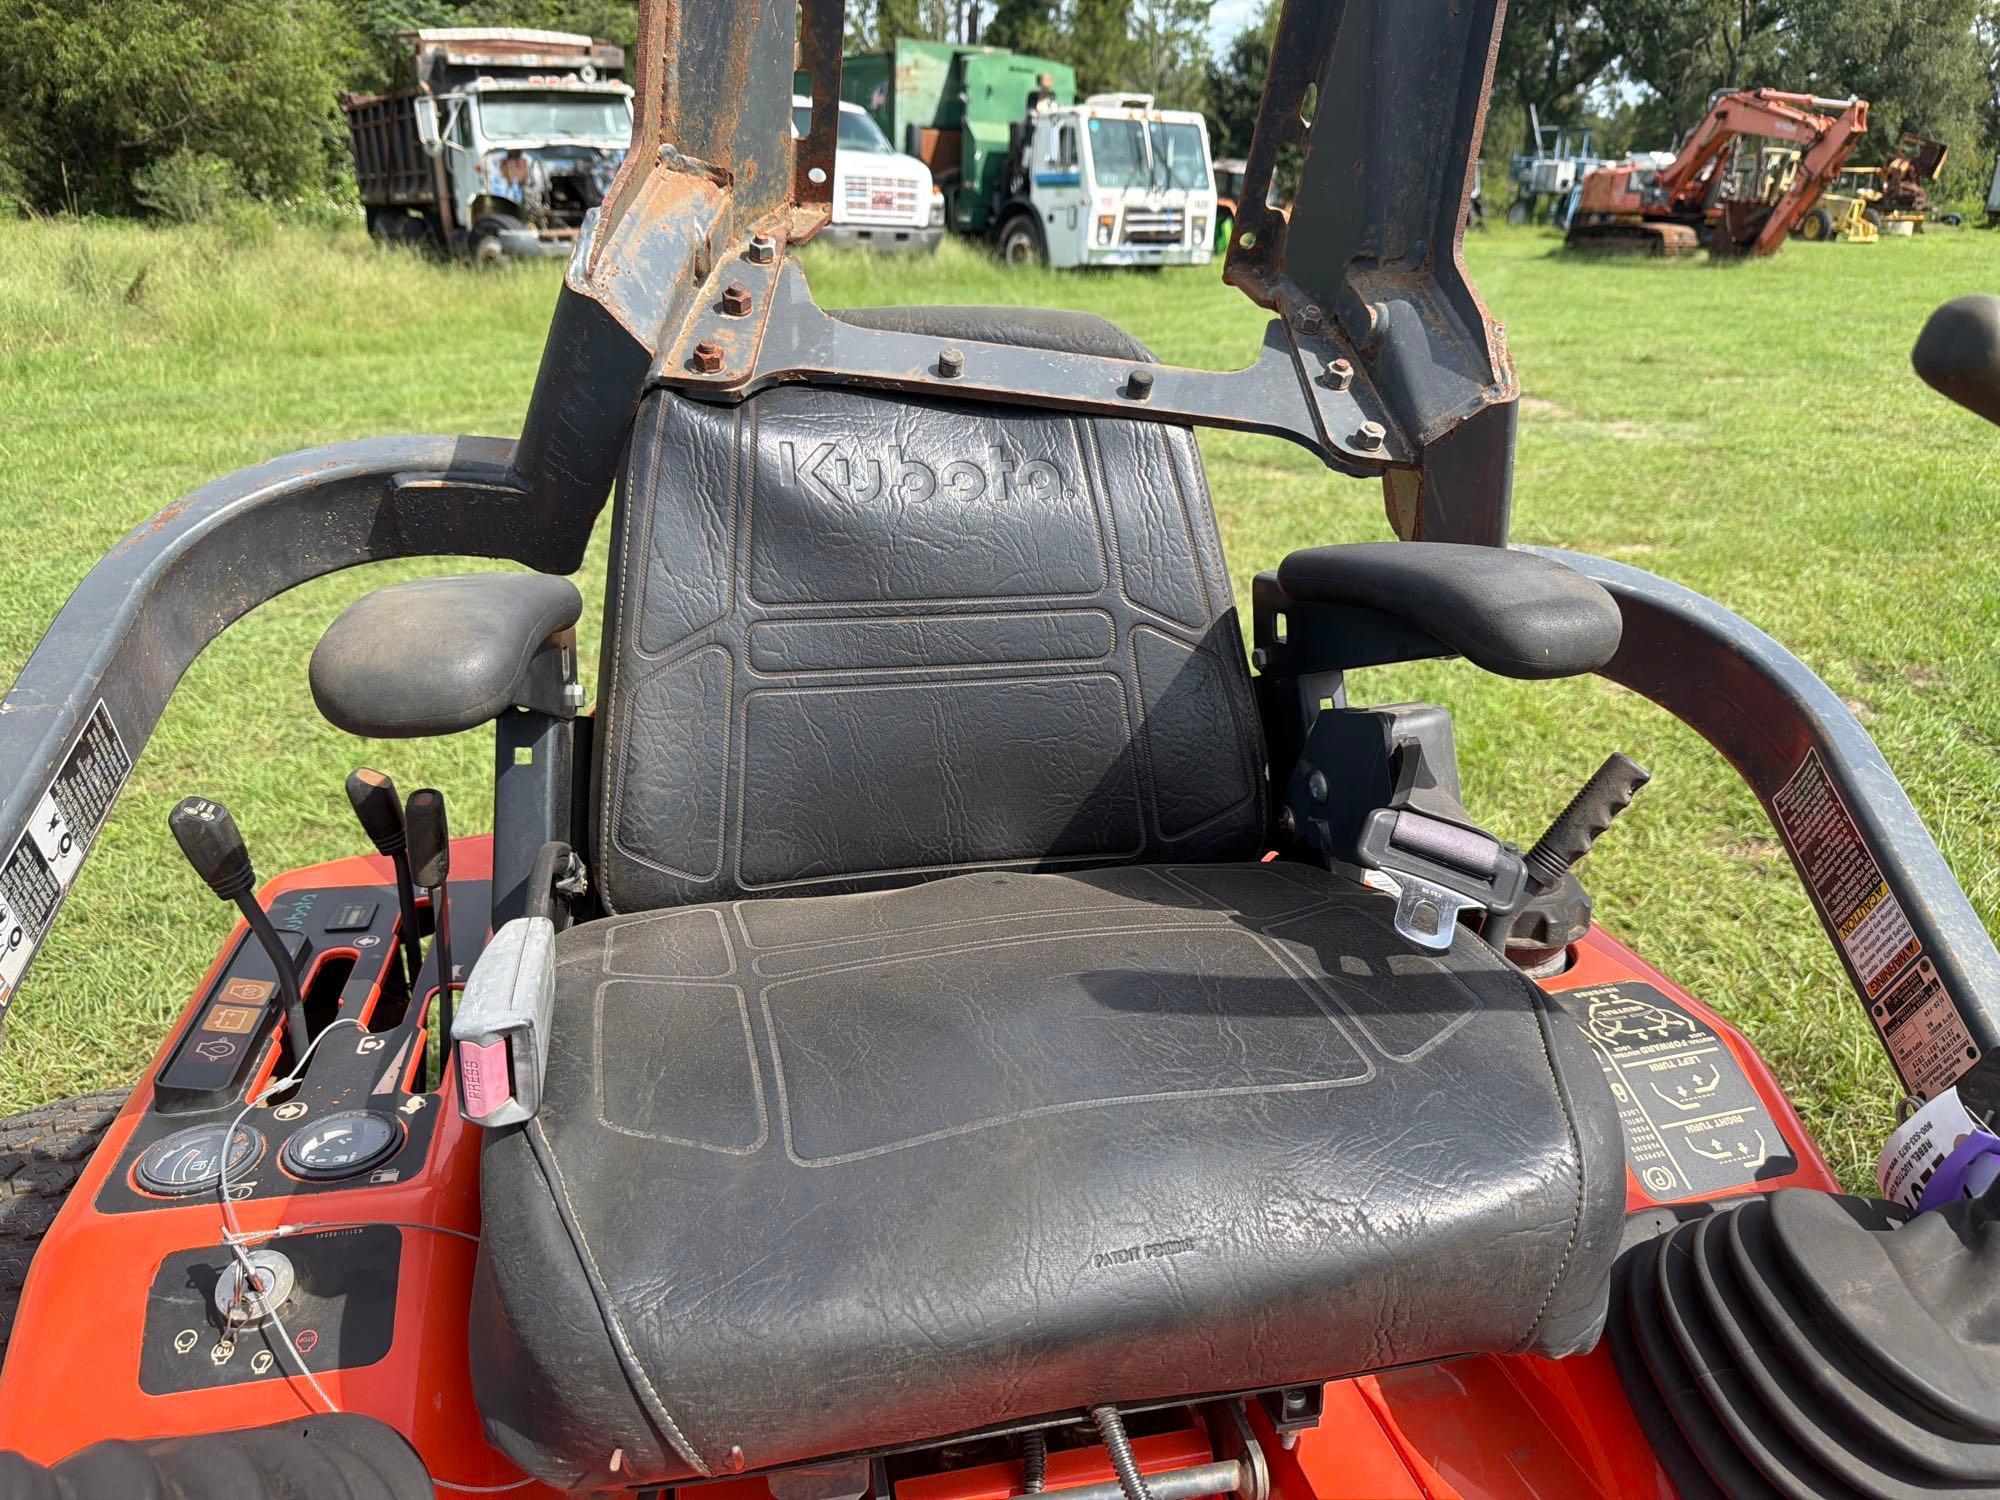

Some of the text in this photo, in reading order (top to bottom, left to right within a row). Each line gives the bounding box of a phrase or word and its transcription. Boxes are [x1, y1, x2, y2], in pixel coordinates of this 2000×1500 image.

[779, 442, 1064, 503] Kubota
[1840, 892, 1878, 936] CAUTION
[1869, 949, 1910, 993] WARNING
[1596, 1005, 1645, 1016] NEUTRAL
[1638, 1039, 1689, 1053] FORWARD
[1647, 1055, 1701, 1072] LEFT TURN
[465, 1060, 482, 1100] PRESS
[1624, 1116, 1644, 1126] UNTIL
[1627, 1124, 1649, 1134] PEDAL
[1683, 1113, 1744, 1134] RIGHT TURN
[1630, 1140, 1660, 1154] PARKING
[1631, 1132, 1655, 1143] BRAKE
[1634, 1148, 1665, 1163] DEPRESS
[1909, 1138, 1934, 1163] REBEL
[1889, 1158, 1917, 1187] AUCTION
[1093, 1239, 1196, 1268] PATENT PENDING
